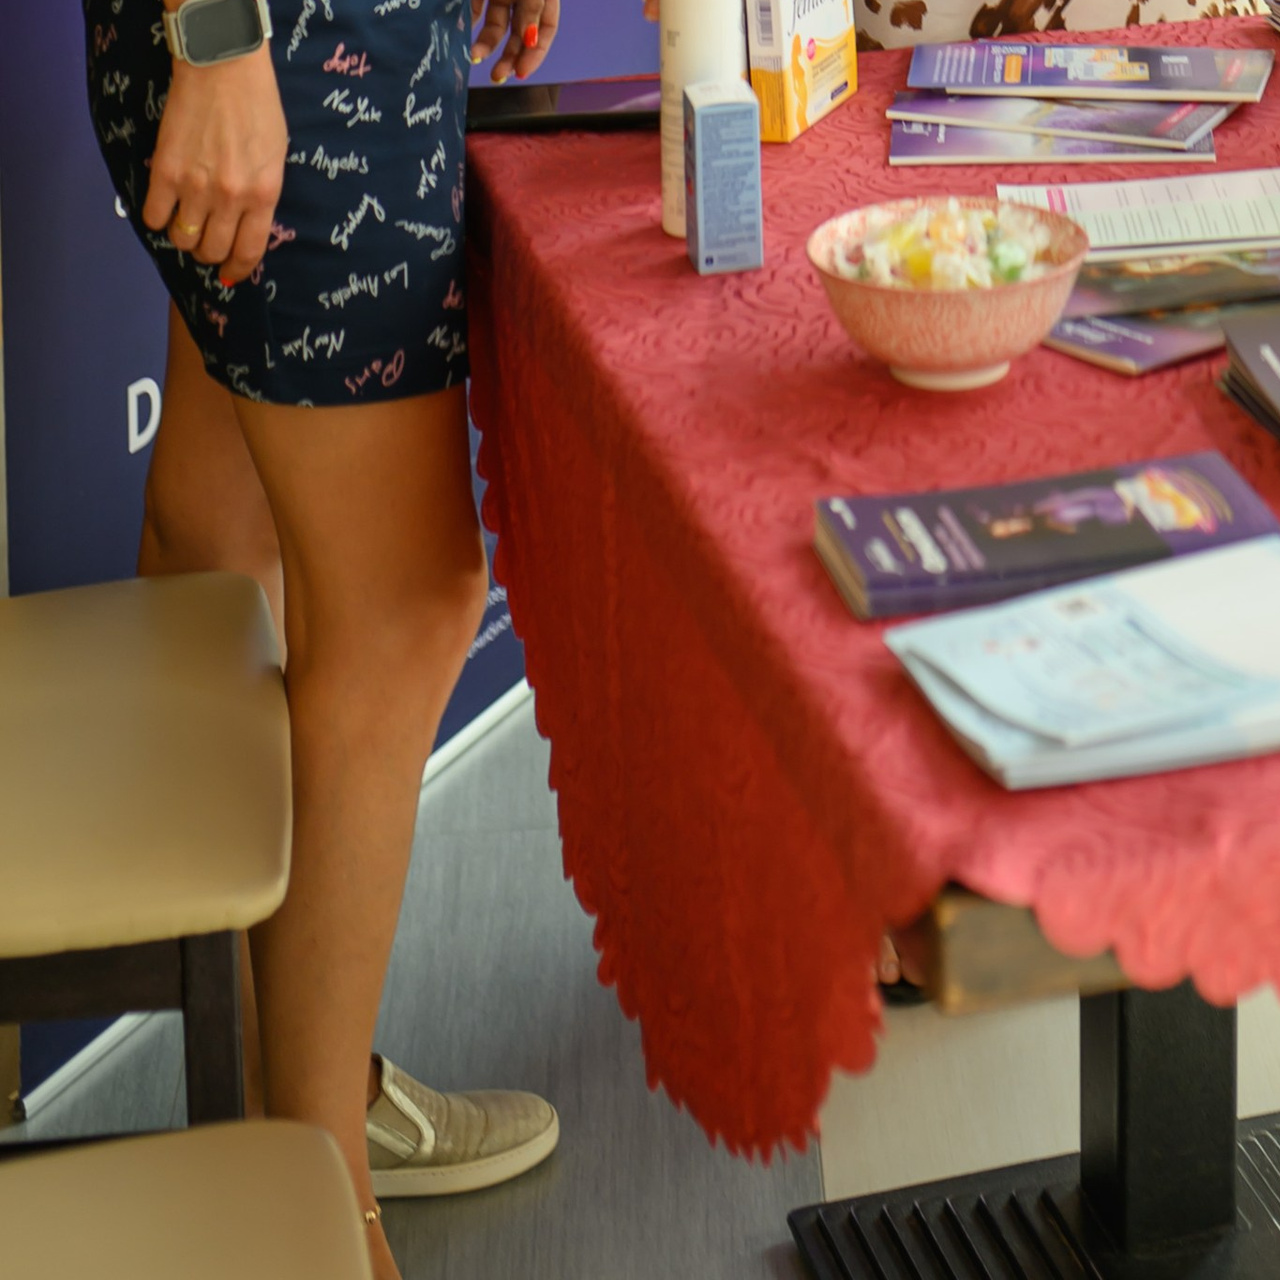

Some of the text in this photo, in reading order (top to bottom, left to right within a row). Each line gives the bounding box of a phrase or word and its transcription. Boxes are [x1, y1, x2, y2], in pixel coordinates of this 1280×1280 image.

[322, 88, 354, 115] New
[286, 143, 369, 180] os Angeles
[317, 260, 409, 310] Los Angeles
[344, 348, 406, 397] Paris
